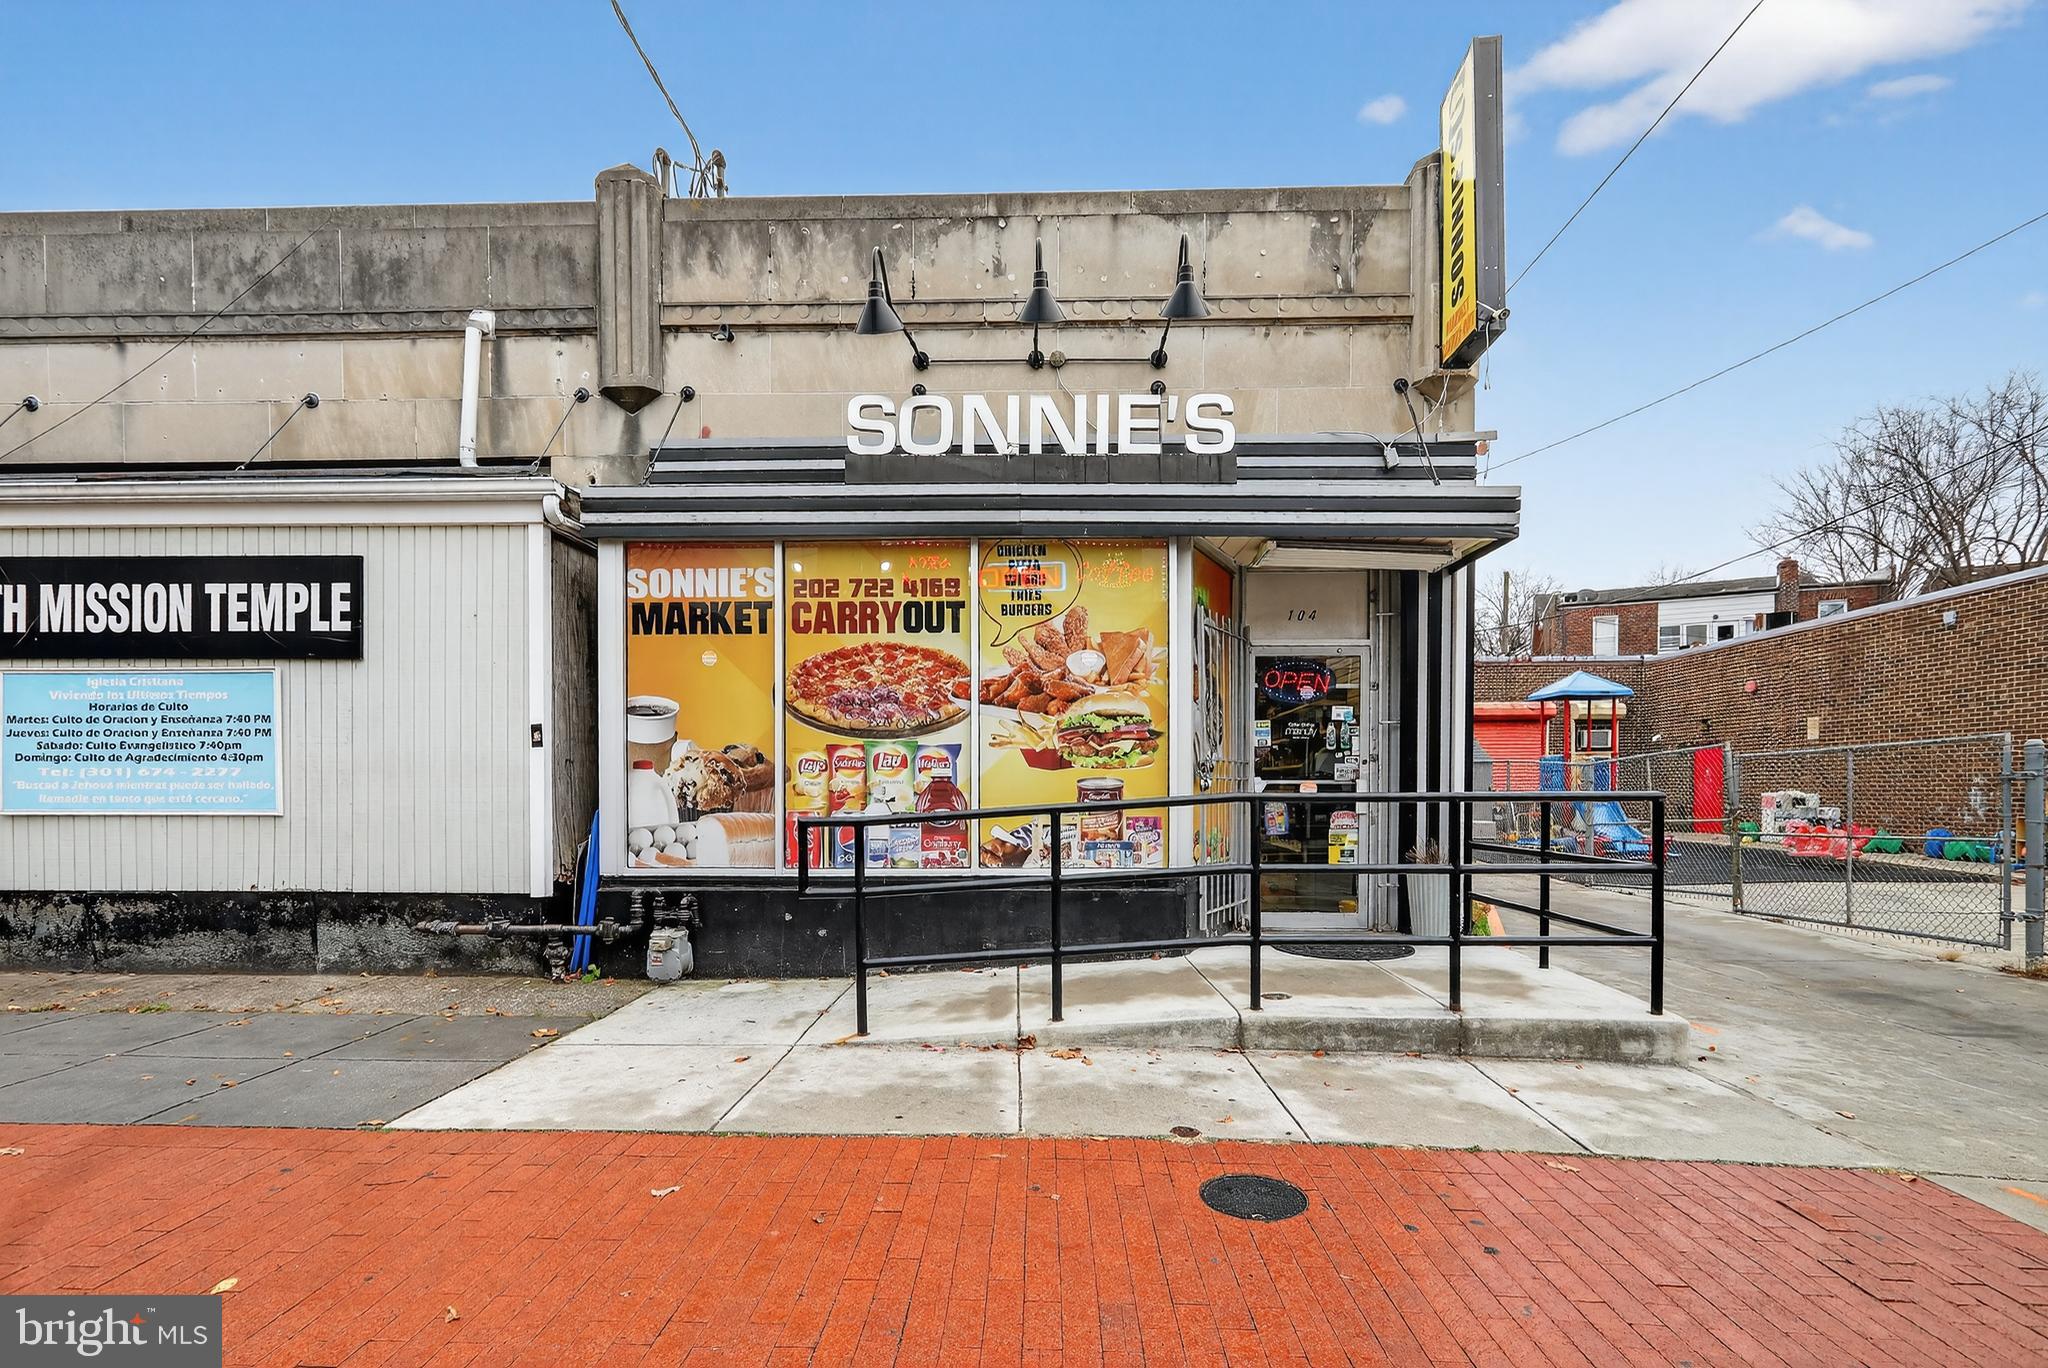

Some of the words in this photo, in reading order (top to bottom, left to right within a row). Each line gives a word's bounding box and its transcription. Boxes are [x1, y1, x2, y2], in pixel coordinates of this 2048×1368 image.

[847, 394, 1236, 455] SONNIE'S
[627, 567, 775, 598] SONNIE'S
[793, 579, 840, 598] 202
[848, 578, 894, 598] 722
[903, 578, 960, 598] 4169
[0, 583, 27, 633] H
[39, 583, 193, 633] MISSION
[205, 582, 351, 632] TEMPLE
[1001, 603, 1052, 616] BURGERS
[631, 601, 773, 635] MARKET
[1288, 609, 1318, 621] 104
[87, 677, 126, 688] Iglesia
[1264, 669, 1331, 693] OPEN
[177, 690, 229, 702] Tiempos
[89, 702, 138, 711] Horarios
[141, 702, 155, 711] de
[158, 702, 189, 711] Culto
[6, 715, 49, 724] Martes:
[52, 715, 83, 724] Culto
[85, 715, 100, 724] de
[103, 715, 148, 724] Oracion
[151, 717, 158, 726] y
[254, 714, 272, 724] PM
[6, 728, 49, 738] Jueves:
[52, 728, 83, 738] Culto
[86, 728, 101, 738] de
[103, 728, 149, 738] Oracion
[151, 731, 158, 740] y
[254, 728, 272, 737] PM
[86, 741, 117, 750] Culto
[15, 753, 71, 764] Domingo:
[75, 753, 105, 762] Culto
[108, 753, 122, 762] de
[125, 753, 217, 764] Agradecimiento
[221, 753, 264, 764] 4:30pm
[40, 767, 75, 777] Tel:
[192, 767, 241, 777] 2277
